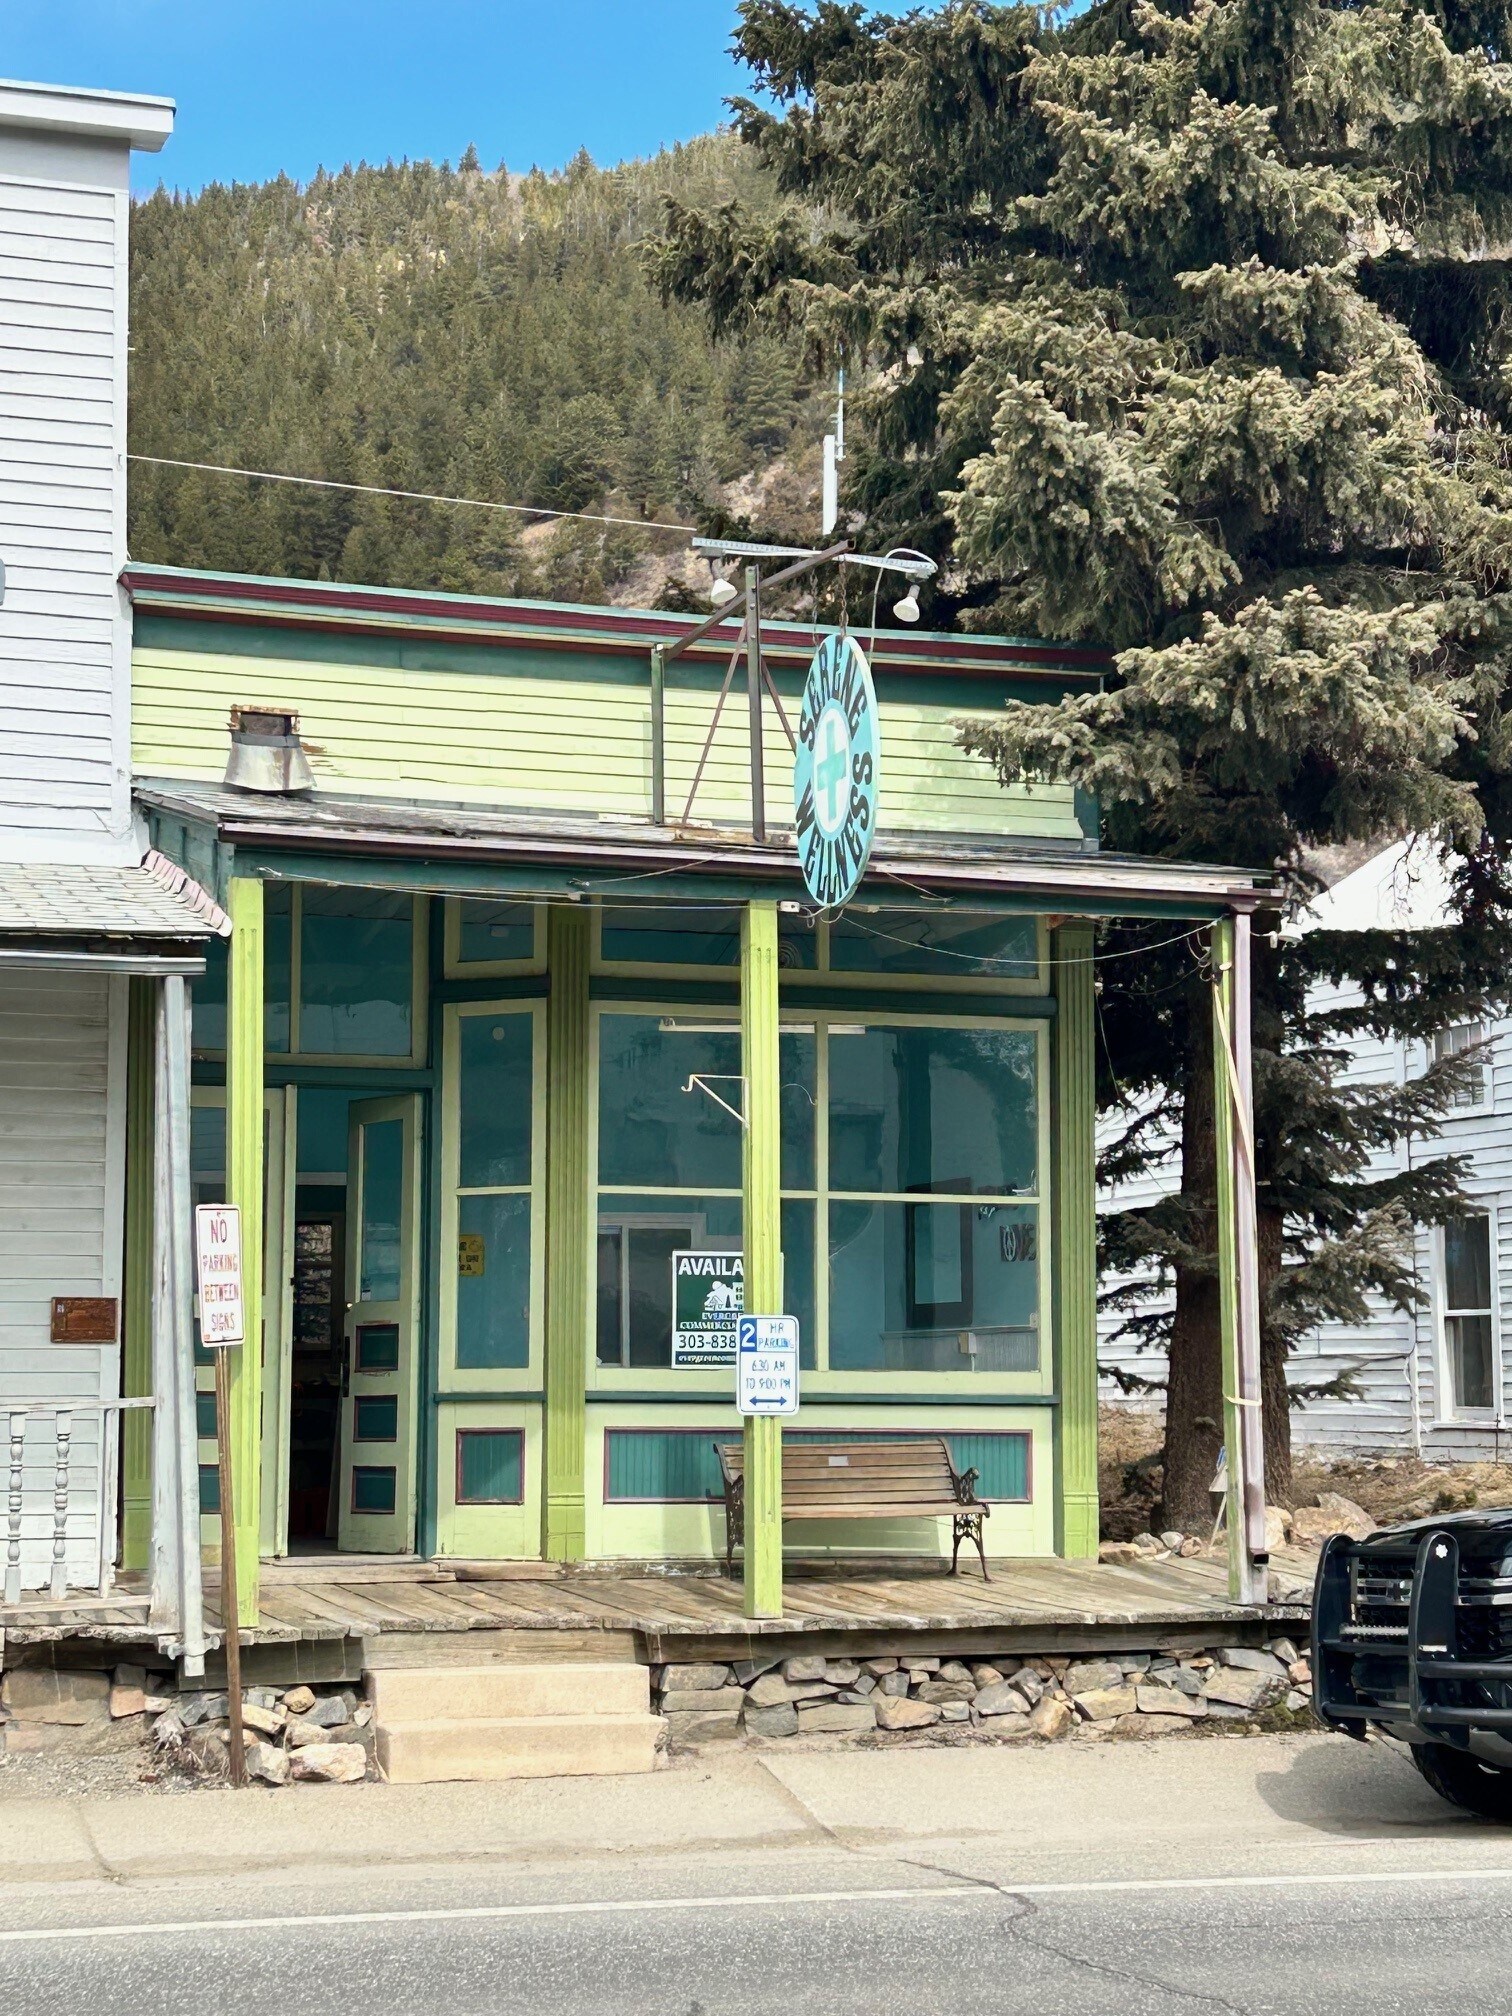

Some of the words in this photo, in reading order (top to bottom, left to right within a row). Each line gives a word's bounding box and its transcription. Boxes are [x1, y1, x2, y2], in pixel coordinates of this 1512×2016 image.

[800, 635, 867, 752] SERENE
[796, 751, 873, 904] WELLNESS
[210, 1219, 228, 1243] NO
[202, 1254, 238, 1272] PARKING
[204, 1283, 239, 1303] BETWEEN
[211, 1312, 235, 1332] SIGNS
[770, 1322, 784, 1333] HR
[741, 1322, 756, 1348] 2
[758, 1337, 794, 1349] PARKING
[773, 1360, 786, 1371] AM
[746, 1377, 756, 1389] TO
[780, 1378, 791, 1389] PM
